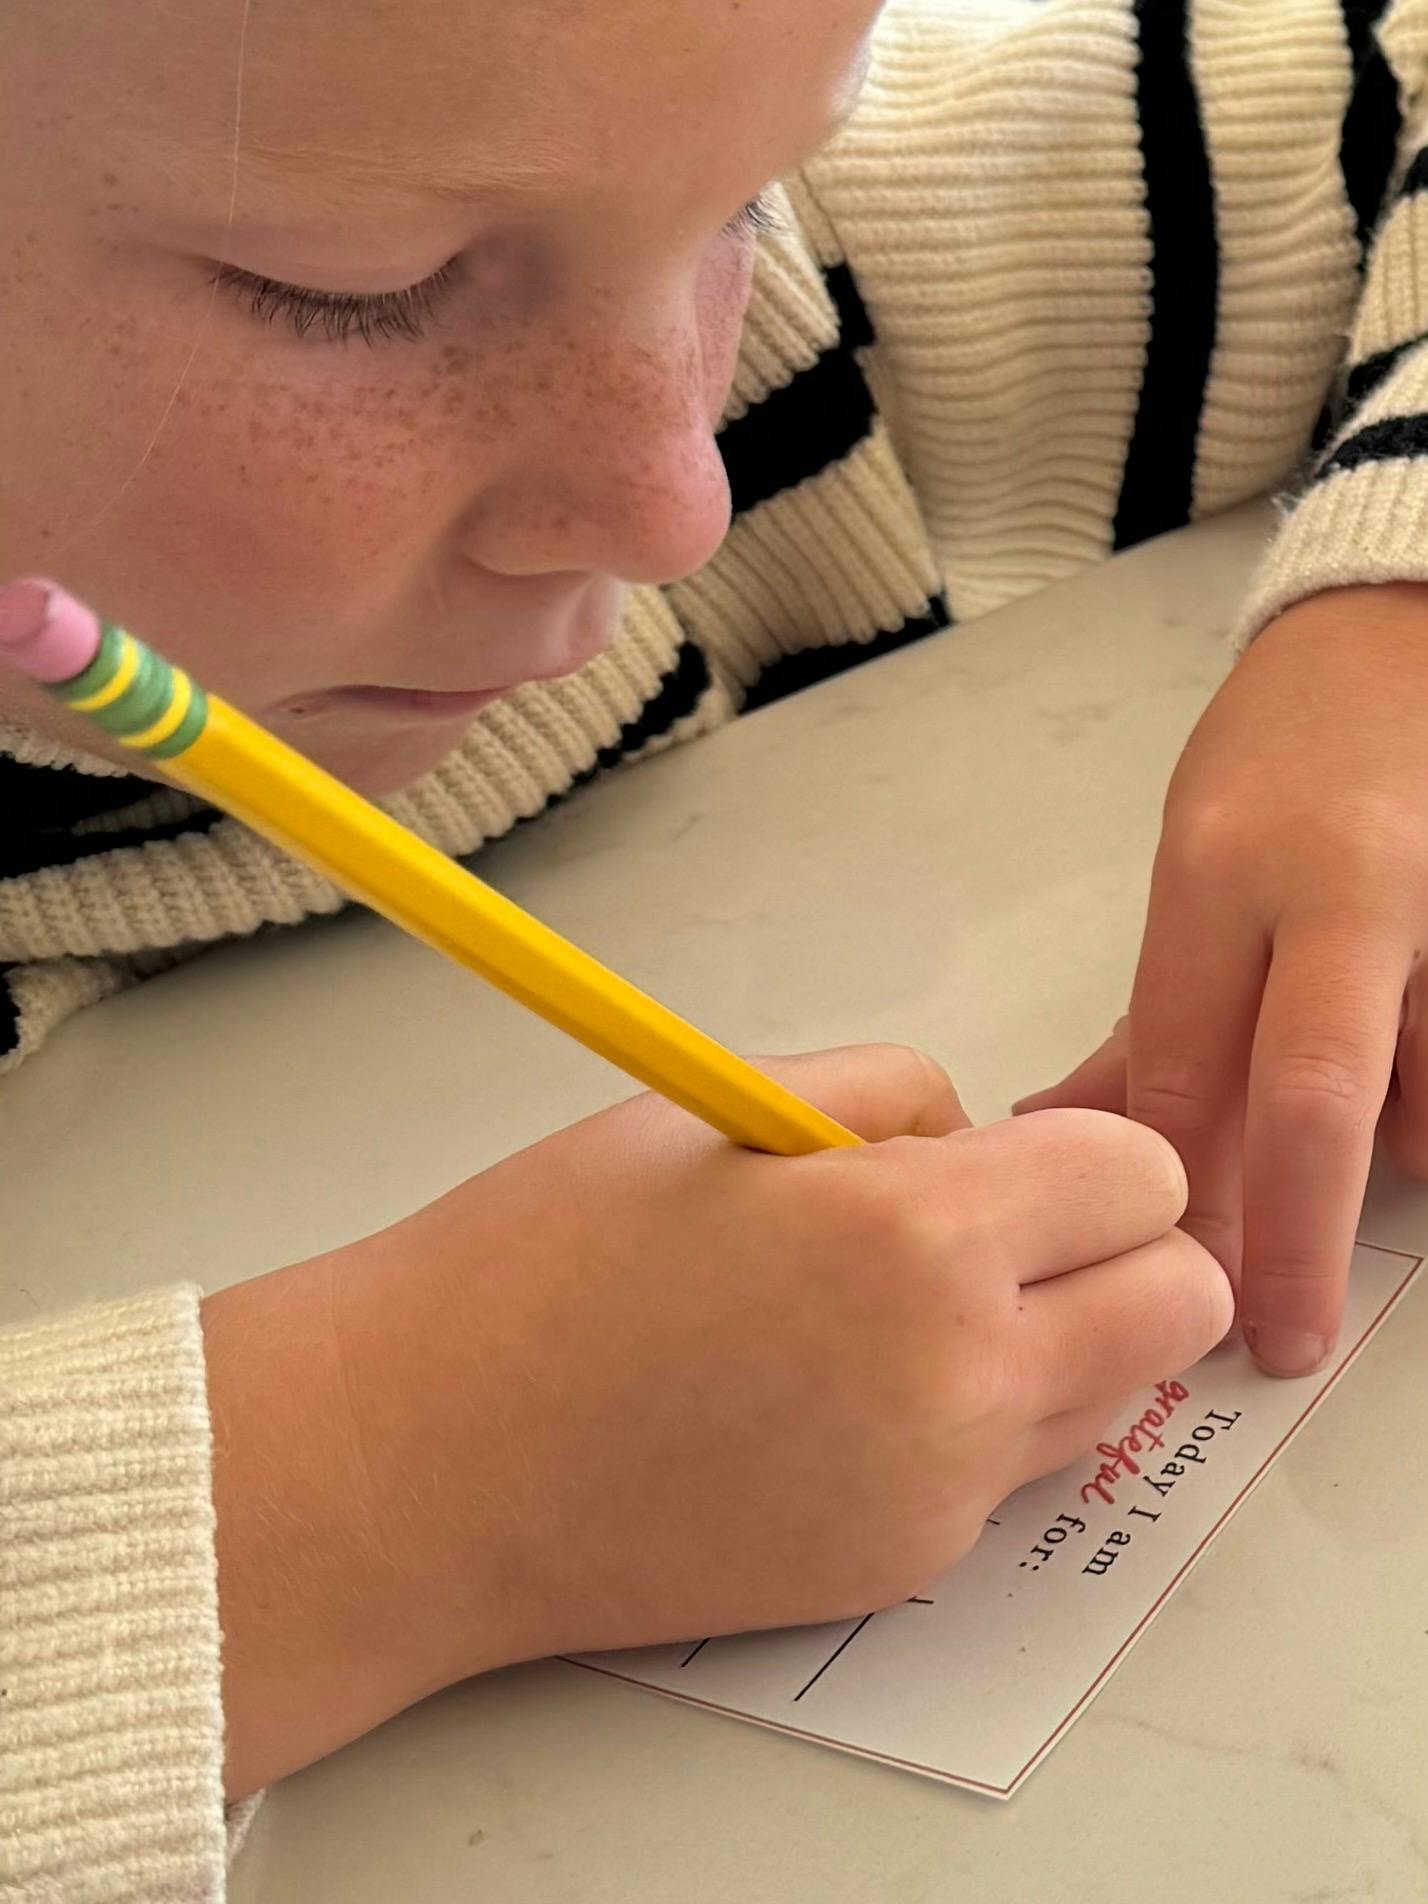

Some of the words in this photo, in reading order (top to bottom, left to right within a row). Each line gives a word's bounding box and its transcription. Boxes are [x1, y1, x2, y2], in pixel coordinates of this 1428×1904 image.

[1079, 1379, 1191, 1506] grateful
[1143, 1408, 1243, 1498] Today
[1017, 1512, 1088, 1573] for:
[1126, 1504, 1163, 1524] I
[1080, 1529, 1133, 1577] am
